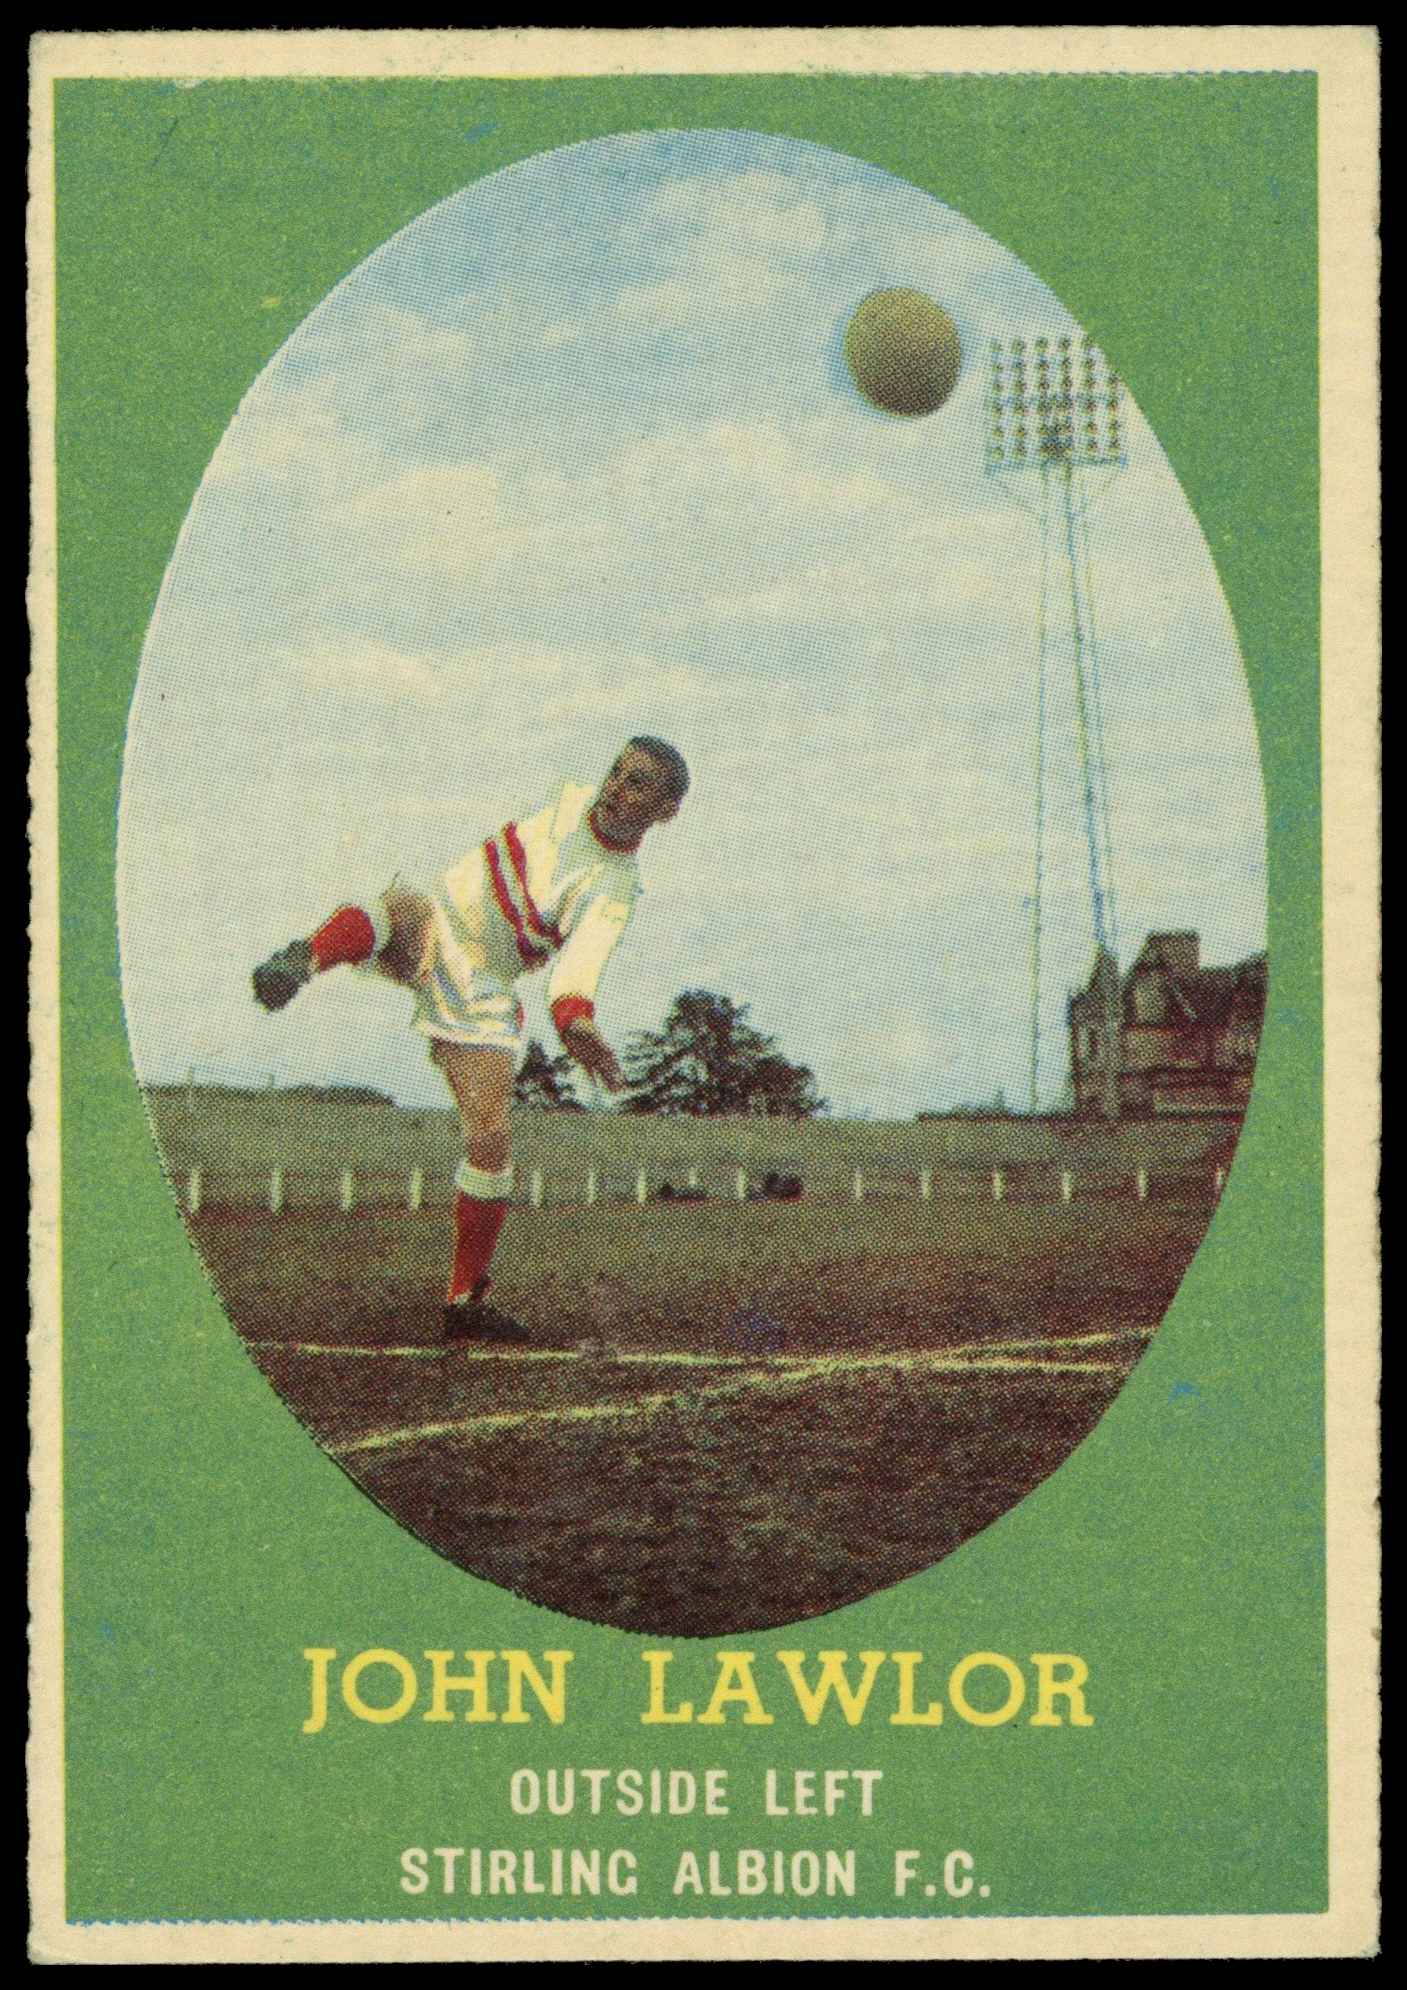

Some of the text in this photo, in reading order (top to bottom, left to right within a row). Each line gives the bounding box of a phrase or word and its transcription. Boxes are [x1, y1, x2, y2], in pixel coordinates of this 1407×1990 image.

[302, 1648, 1094, 1734] JOHN LAWLOR
[510, 1768, 883, 1817] OUTSIDE LEFT
[400, 1847, 990, 1898] STIRLING ALBION F.C.
